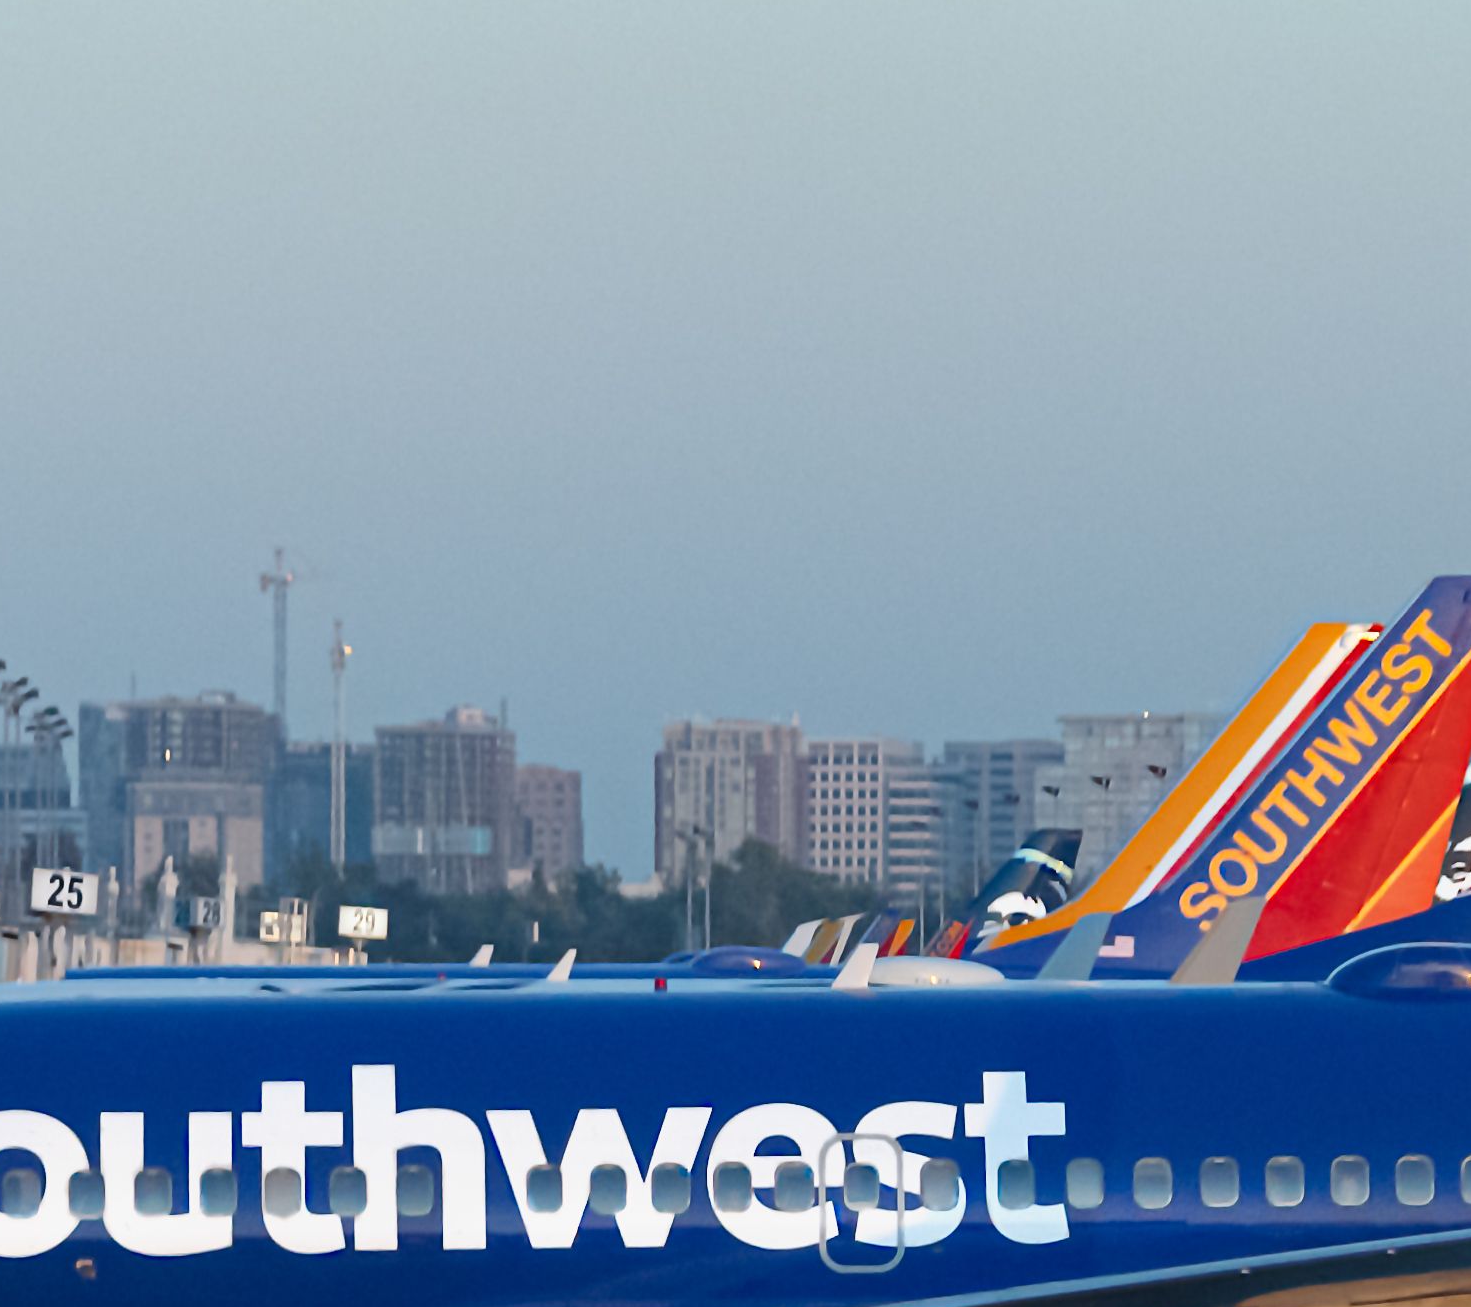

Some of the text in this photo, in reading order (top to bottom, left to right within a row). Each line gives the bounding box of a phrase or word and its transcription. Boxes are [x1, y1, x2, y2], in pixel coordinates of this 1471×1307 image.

[1179, 609, 1452, 931] SOUTHWEST
[47, 874, 83, 910] 25
[354, 908, 376, 933] 29
